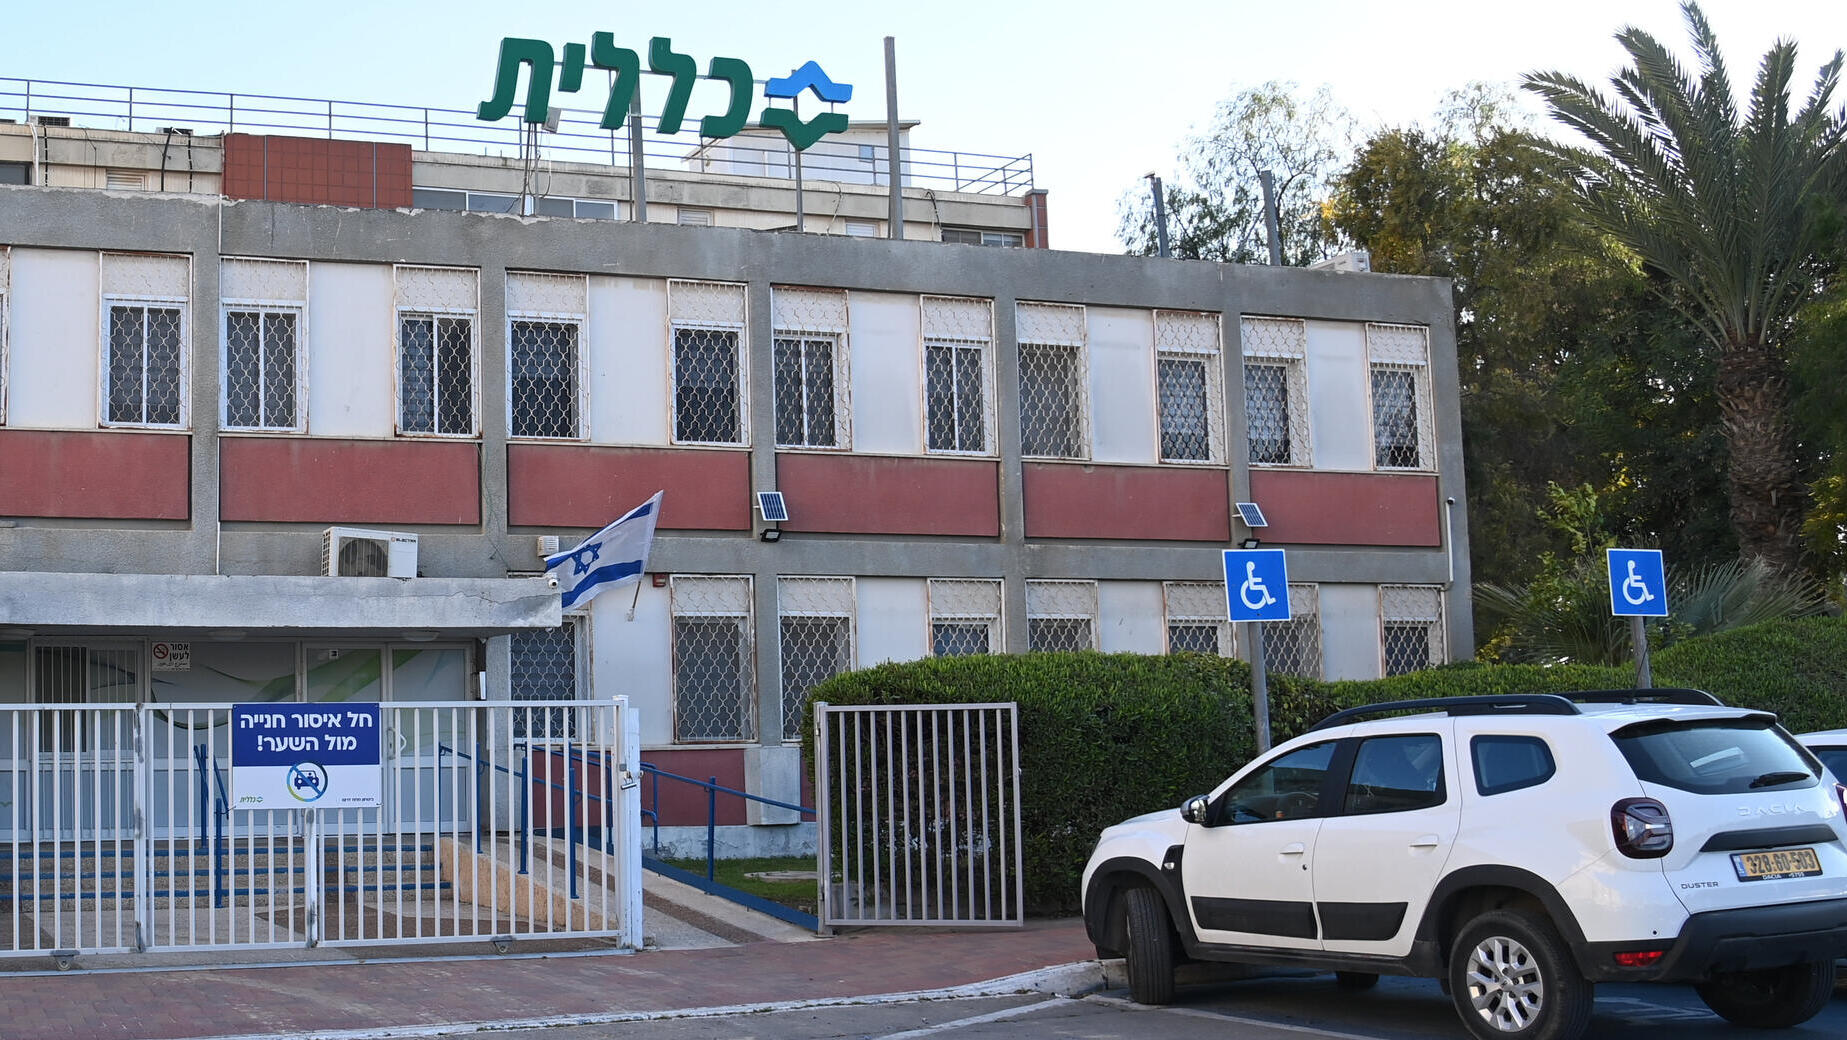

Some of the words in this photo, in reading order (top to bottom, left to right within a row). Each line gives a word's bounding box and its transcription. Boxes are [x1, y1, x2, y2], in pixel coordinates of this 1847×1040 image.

[476, 31, 754, 139] כללית
[170, 643, 189, 651] אסור
[169, 651, 190, 661] לעשן
[240, 713, 286, 729] חנייה
[291, 713, 341, 728] איסור
[347, 711, 373, 728] חל
[257, 734, 319, 752] השער!
[324, 734, 357, 751] מול
[1681, 881, 1719, 889] DUSTER
